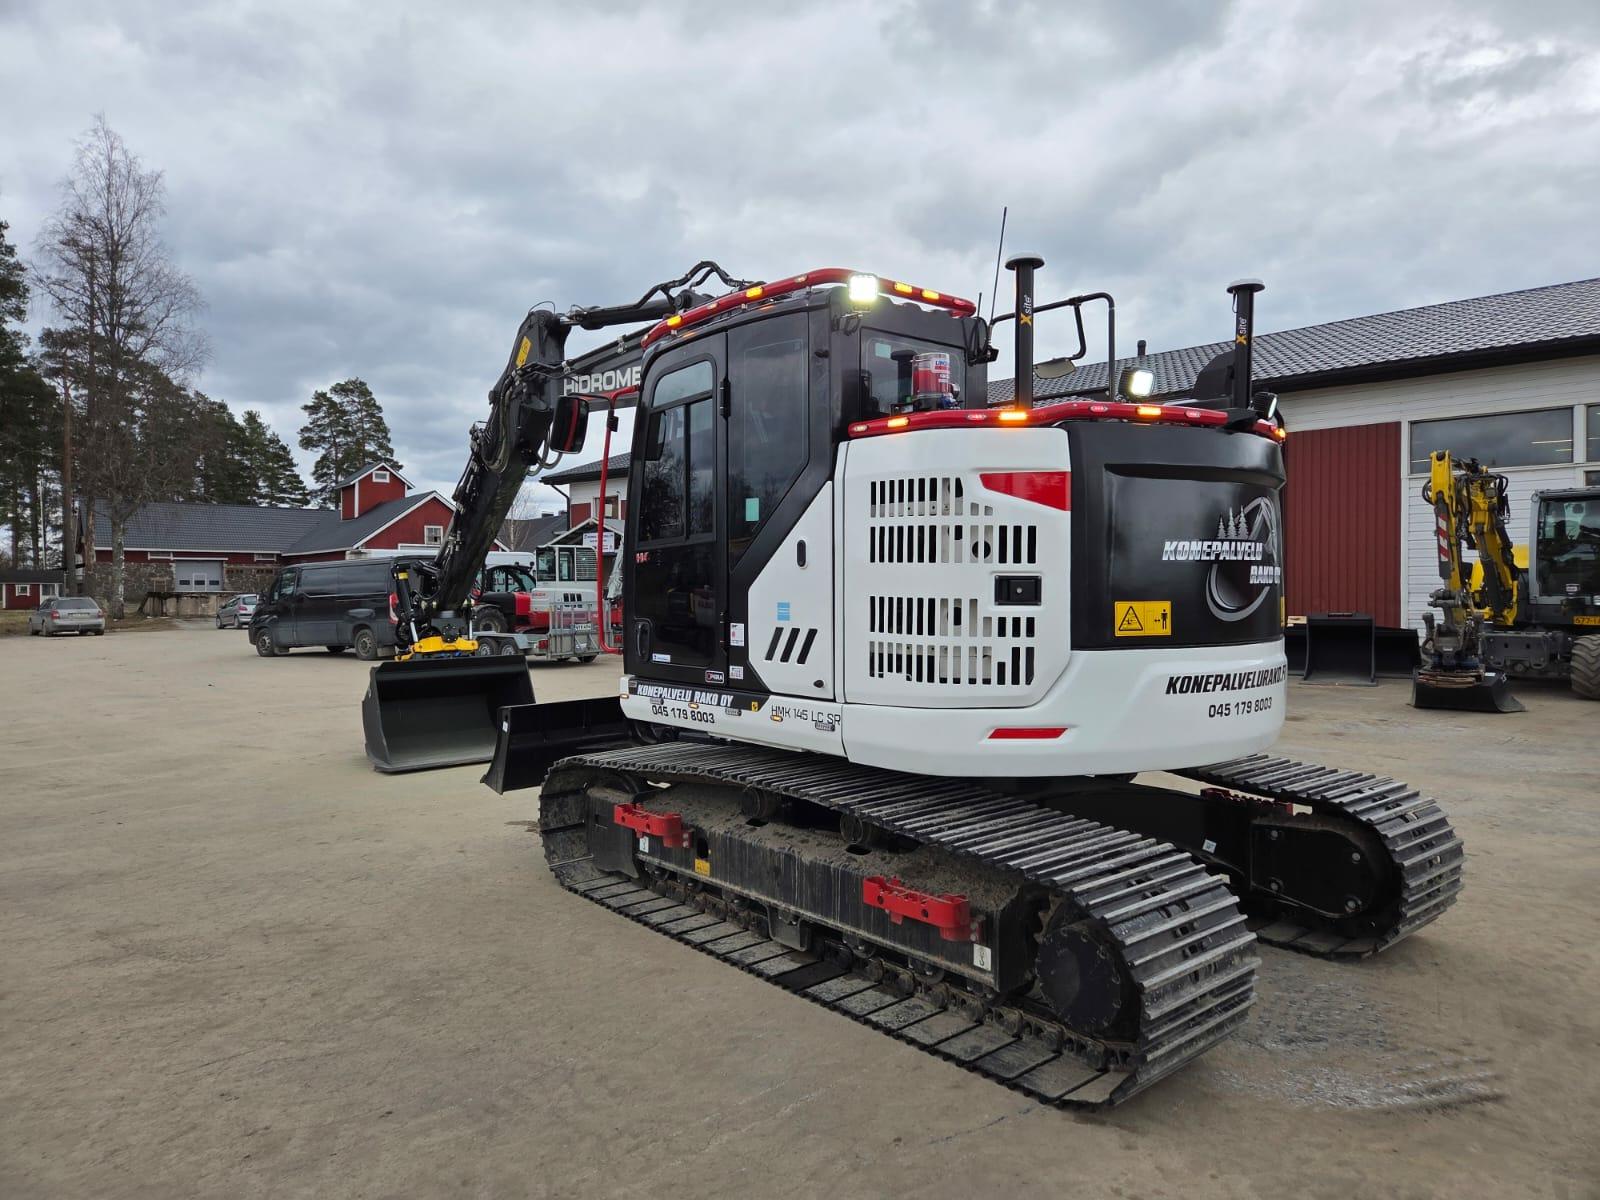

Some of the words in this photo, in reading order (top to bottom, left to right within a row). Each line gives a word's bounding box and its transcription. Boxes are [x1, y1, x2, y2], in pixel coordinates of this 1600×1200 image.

[1162, 541, 1264, 560] KONEPALVELU
[1249, 565, 1274, 584] RAKO
[637, 684, 692, 702] KONEPALVELU
[693, 691, 719, 706] RAKO
[720, 694, 734, 707] OY
[652, 705, 669, 717] 045
[671, 708, 688, 720] 179
[690, 710, 715, 723] 8003
[771, 704, 791, 718] HMK
[793, 708, 808, 720] 145
[811, 711, 824, 723] LC
[827, 713, 840, 726] SR
[1208, 703, 1231, 718] 045
[1234, 700, 1252, 715] 179
[1254, 697, 1273, 712] 8003
